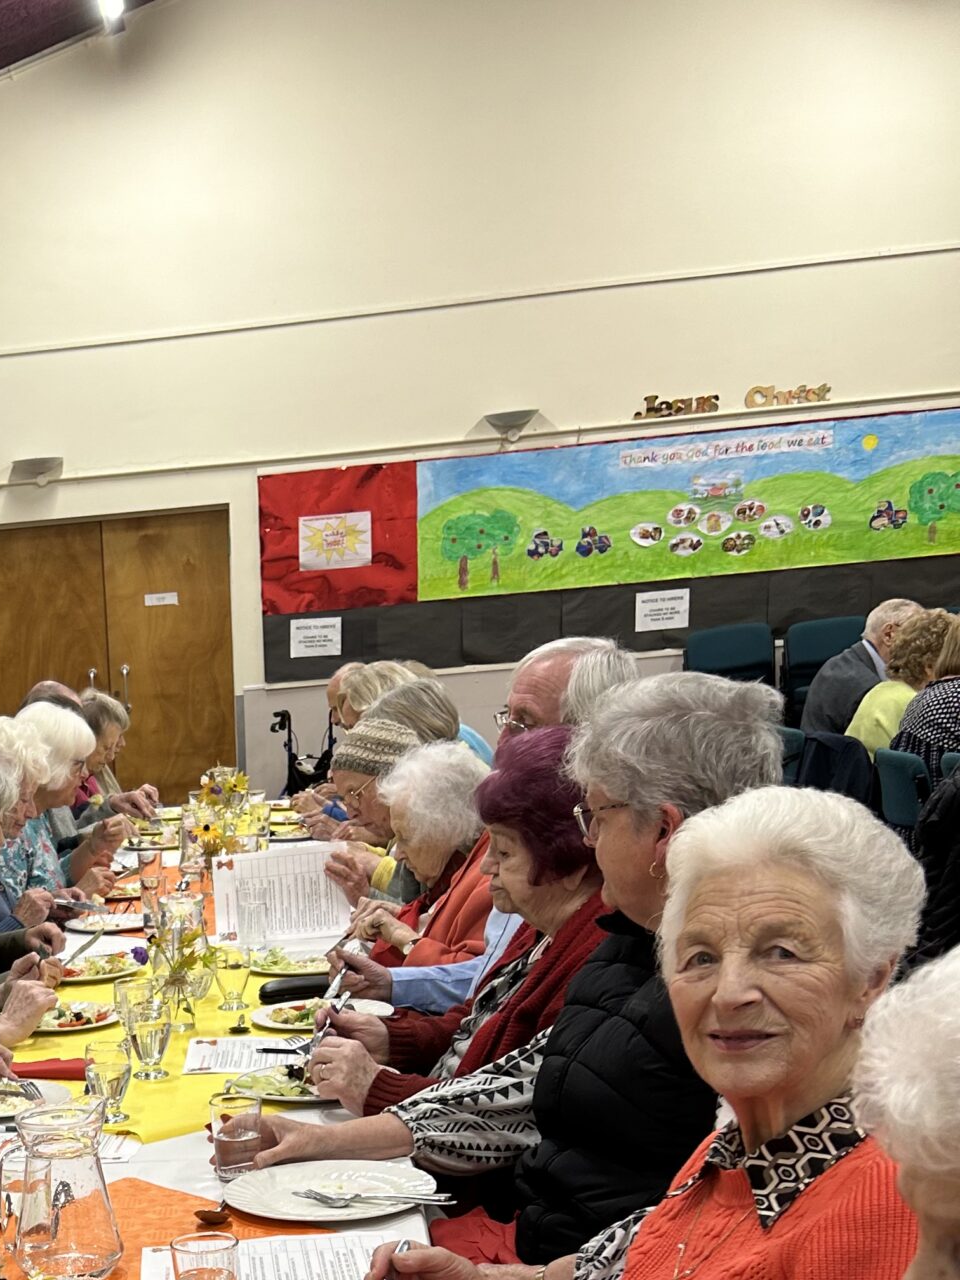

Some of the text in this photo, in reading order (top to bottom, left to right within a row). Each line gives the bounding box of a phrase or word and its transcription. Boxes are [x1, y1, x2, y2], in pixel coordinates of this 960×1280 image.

[633, 383, 831, 420] Jesus Christ
[621, 450, 658, 465] Thank
[662, 452, 683, 464] you
[713, 444, 731, 457] for
[735, 441, 754, 453] the
[756, 437, 783, 451] food
[787, 438, 804, 448] we
[807, 435, 826, 446] eat
